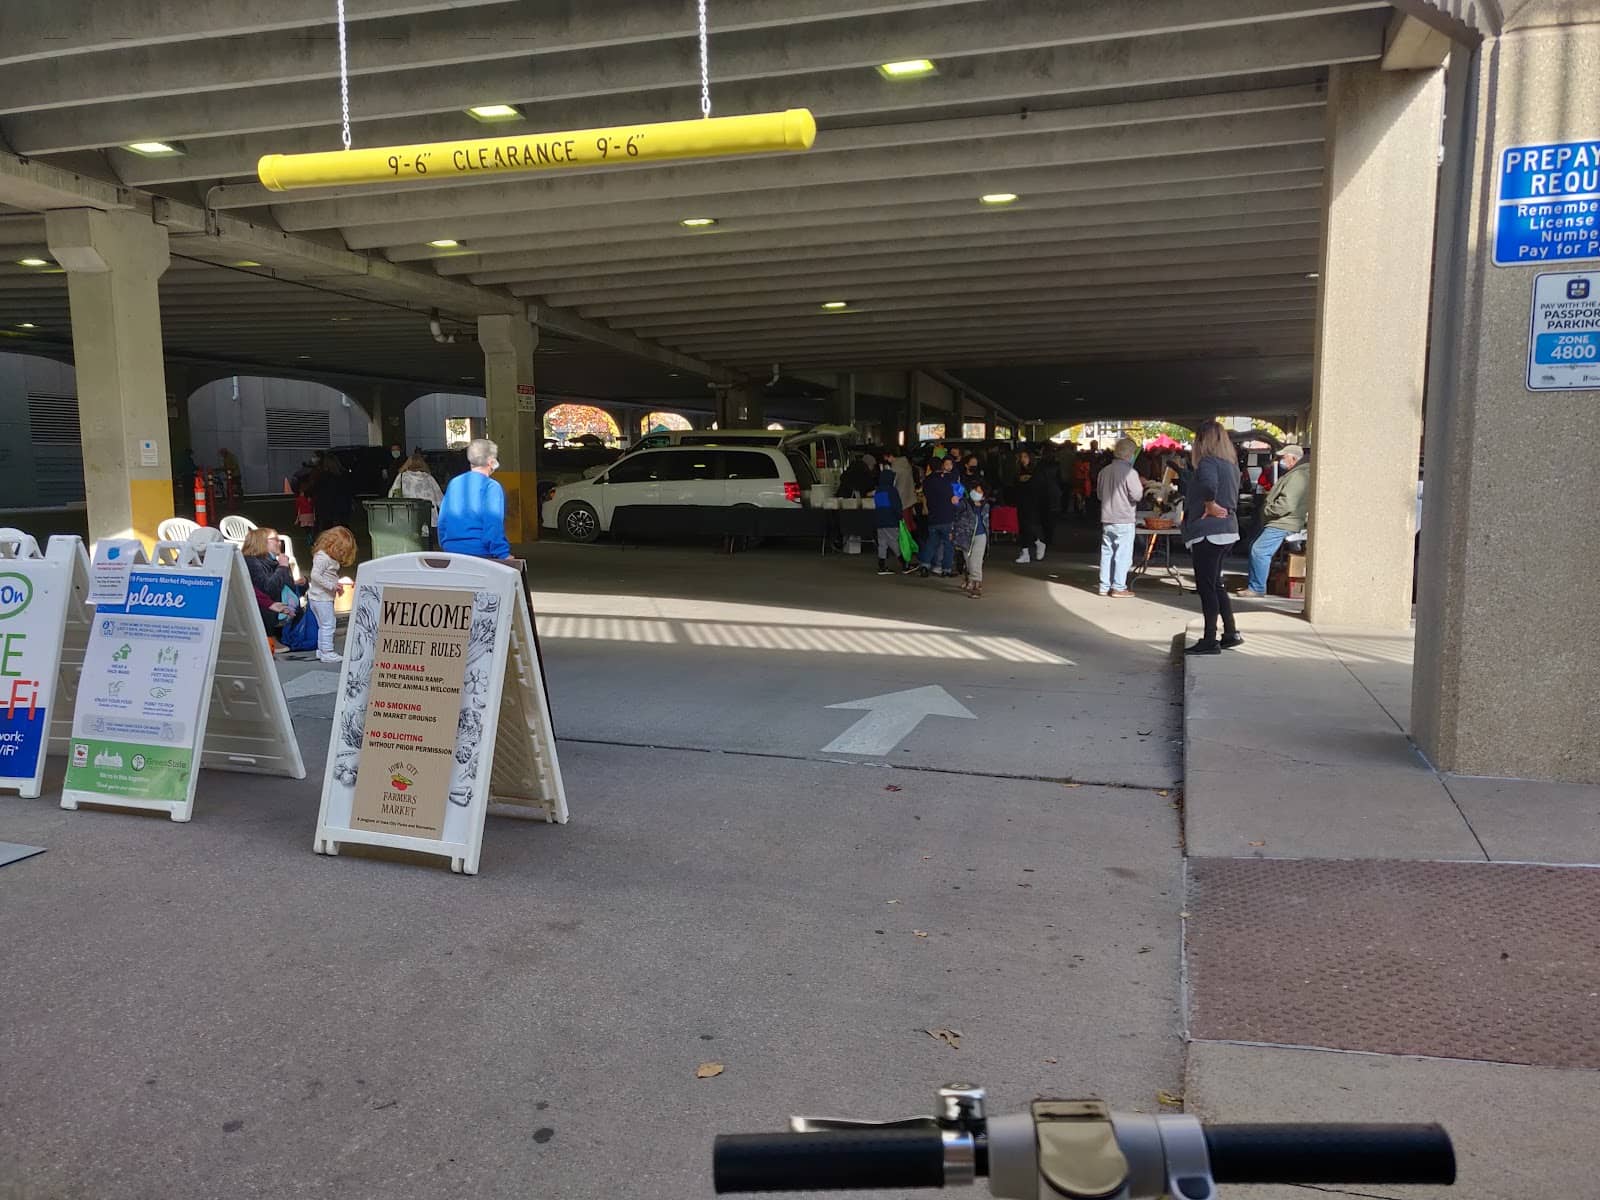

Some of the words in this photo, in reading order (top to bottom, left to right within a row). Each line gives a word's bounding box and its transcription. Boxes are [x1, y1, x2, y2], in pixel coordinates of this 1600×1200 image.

[453, 140, 578, 171] CLEARANCE
[1531, 170, 1599, 195] REQU
[1517, 201, 1599, 217] Remembe
[1530, 215, 1594, 230] License
[1541, 228, 1599, 243] Numbe
[1519, 245, 1549, 258] Pay
[1557, 243, 1581, 255] for
[1588, 241, 1600, 253] P
[1558, 302, 1579, 310] WITH
[1559, 335, 1589, 345] ZONE
[1551, 345, 1596, 359] 4800
[1, 586, 24, 604] On
[126, 585, 186, 613] please
[383, 600, 472, 631] WELCOME
[383, 638, 426, 656] MARKET
[430, 642, 462, 658] RULES
[380, 661, 391, 670] NO
[392, 663, 425, 673] ANIMALS
[386, 673, 397, 681] THE
[398, 675, 424, 683] PARKING
[377, 681, 401, 689] SERVICE
[402, 684, 429, 692] ANIMALS
[430, 686, 460, 694] WELCOME
[374, 700, 385, 709] NO
[387, 702, 422, 712] SMOKING
[383, 712, 407, 720] MARKET
[370, 731, 381, 739] NO
[383, 732, 423, 743] SOLICITING
[369, 741, 395, 749] WITHOUT
[415, 746, 452, 755] PERMISSION
[388, 761, 404, 774] IOWA
[406, 763, 419, 777] CITY
[381, 803, 417, 817] MARKET
